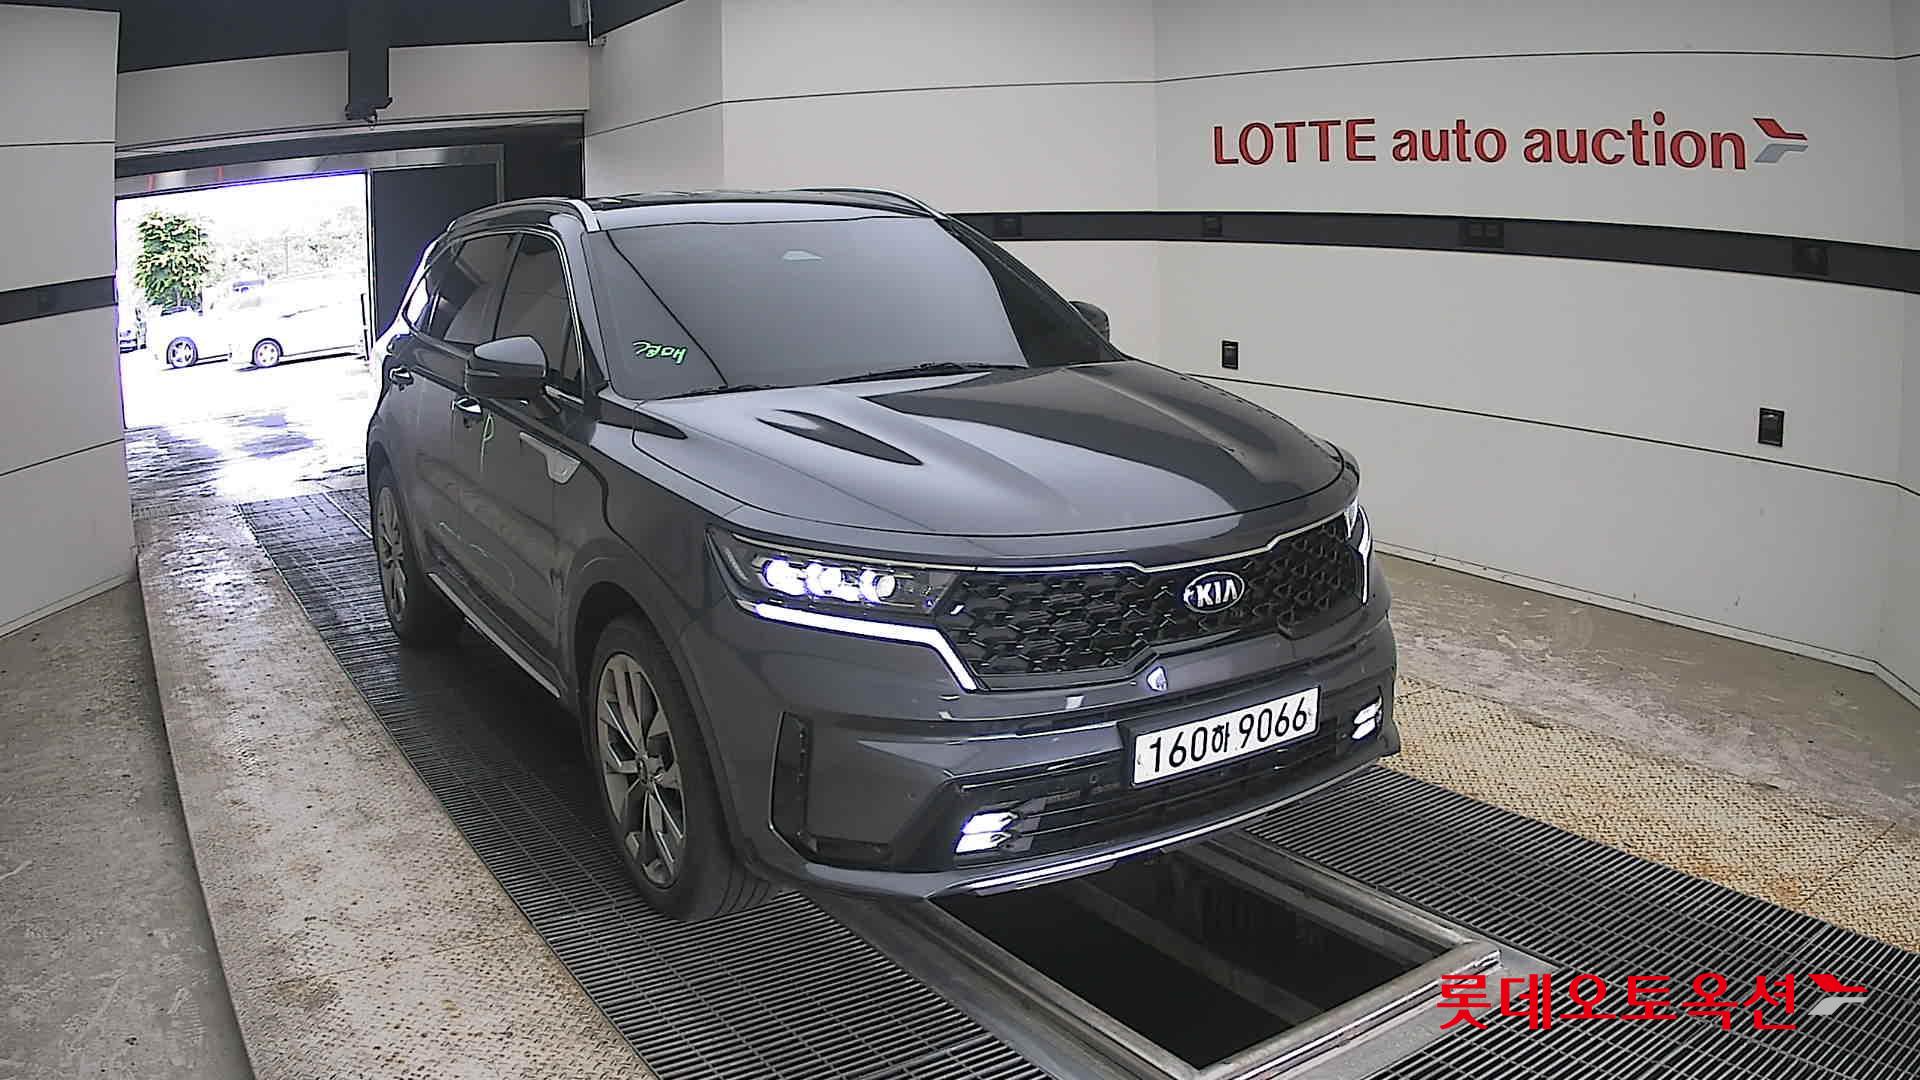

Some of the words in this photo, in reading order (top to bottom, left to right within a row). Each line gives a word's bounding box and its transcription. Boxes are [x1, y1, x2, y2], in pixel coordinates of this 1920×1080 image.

[1214, 118, 1377, 165] LOTTE
[1392, 119, 1508, 163] auto
[1523, 111, 1747, 170] auction
[1195, 579, 1238, 608] KIA
